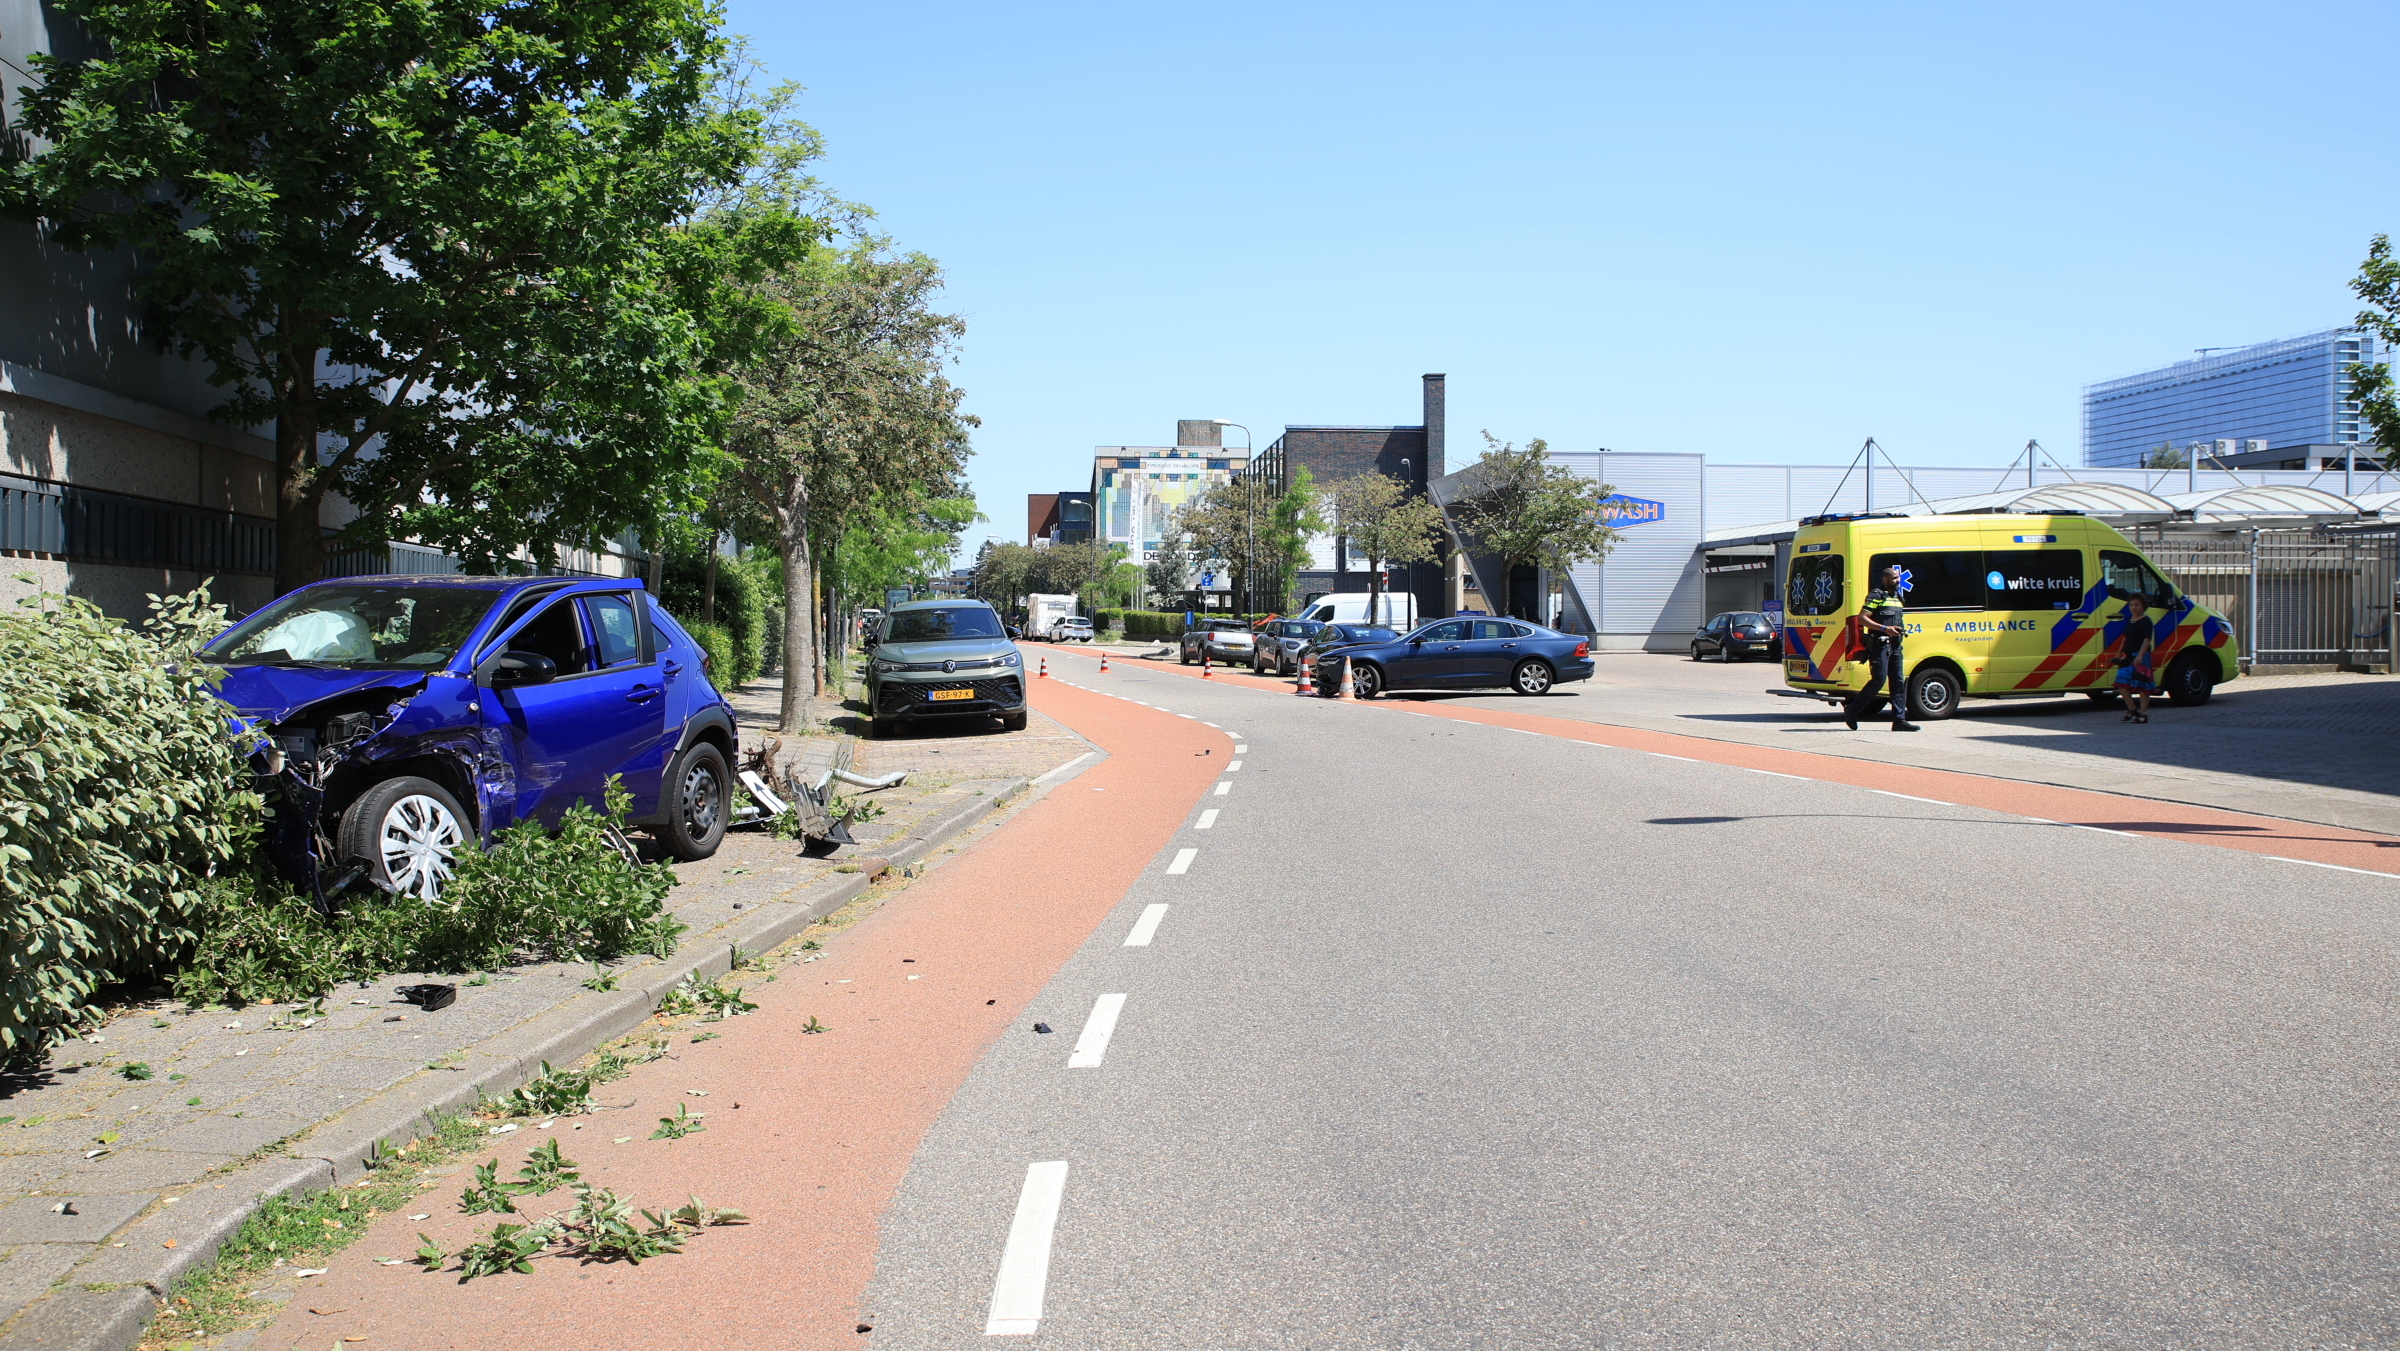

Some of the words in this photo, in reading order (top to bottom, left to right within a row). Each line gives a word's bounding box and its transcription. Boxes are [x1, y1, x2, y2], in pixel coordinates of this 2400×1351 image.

[2007, 576, 2044, 590] witte
[2047, 576, 2081, 590] kruis
[1901, 623, 1923, 634] 24
[1945, 620, 2036, 633] AMBULANCE
[935, 691, 971, 700] GSF-97-K
